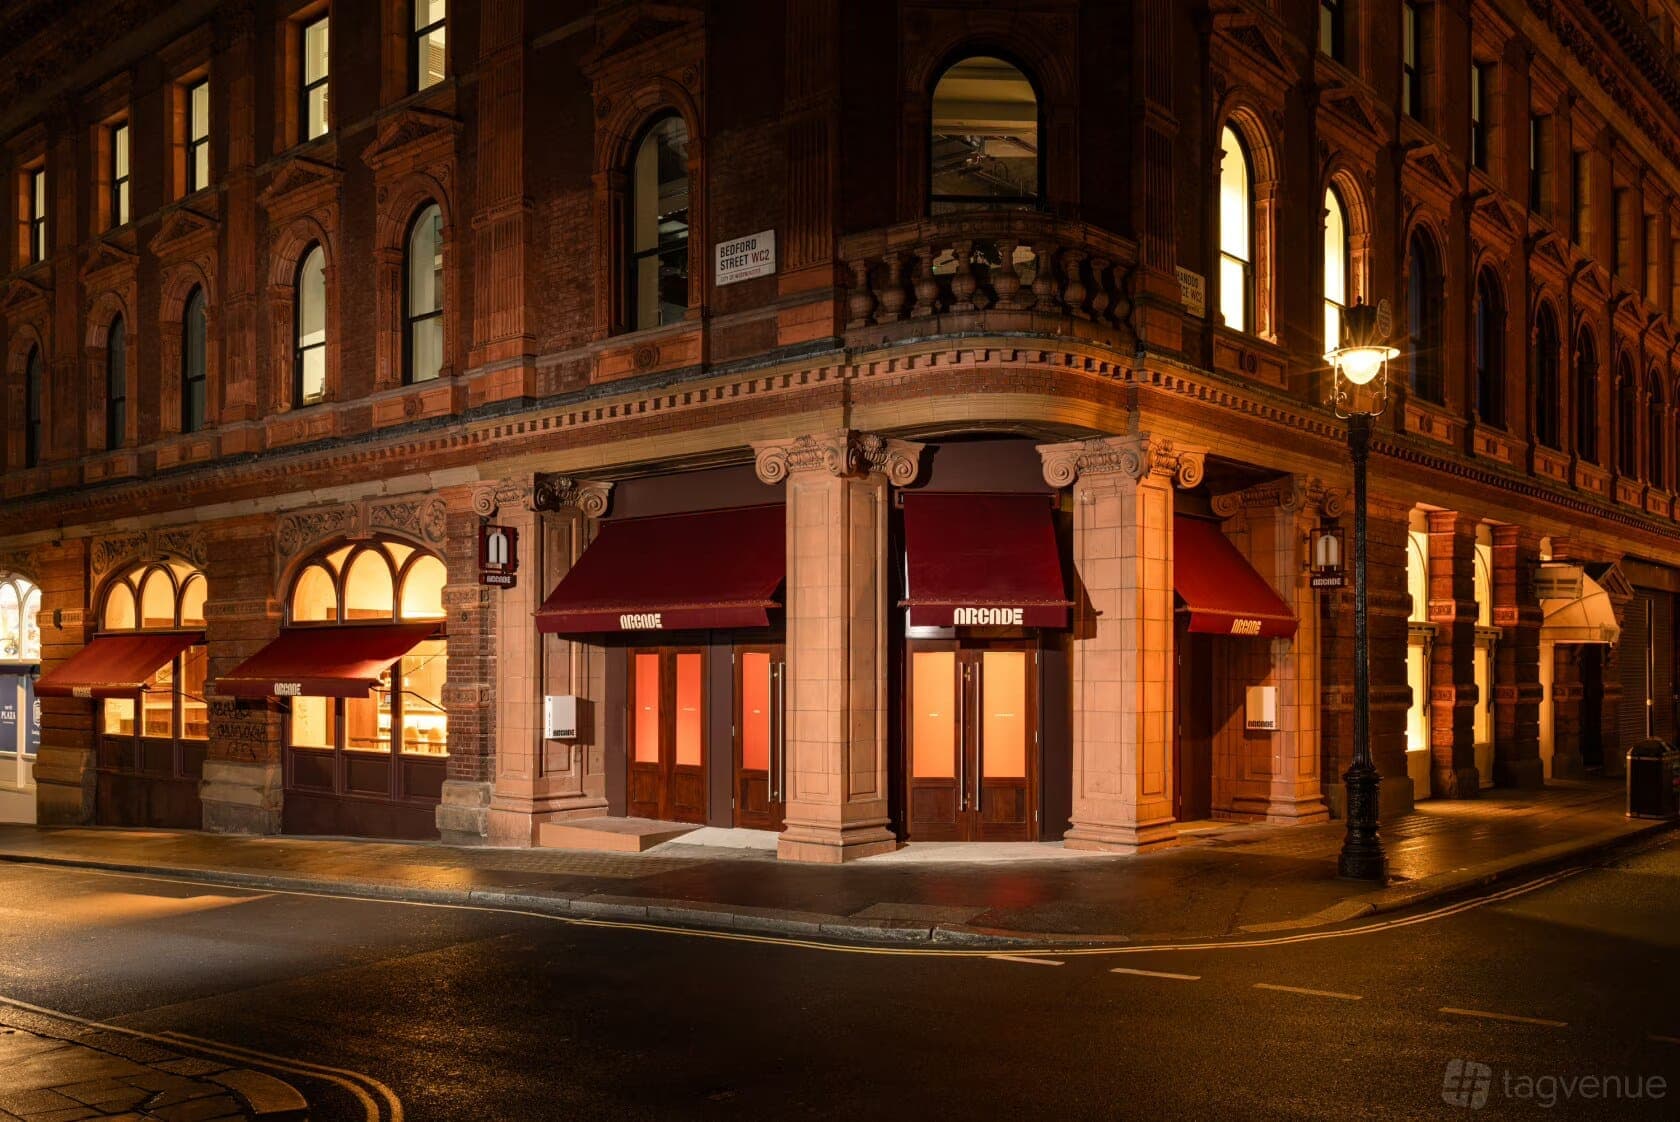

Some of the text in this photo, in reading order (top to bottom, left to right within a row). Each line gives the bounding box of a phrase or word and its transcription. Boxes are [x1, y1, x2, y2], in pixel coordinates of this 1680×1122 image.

[720, 239, 757, 258] BEDFORD
[720, 249, 770, 271] STREET WC2
[620, 613, 663, 630] ARCADE
[953, 607, 1024, 625] ARCADE
[274, 682, 302, 696] ARCADE
